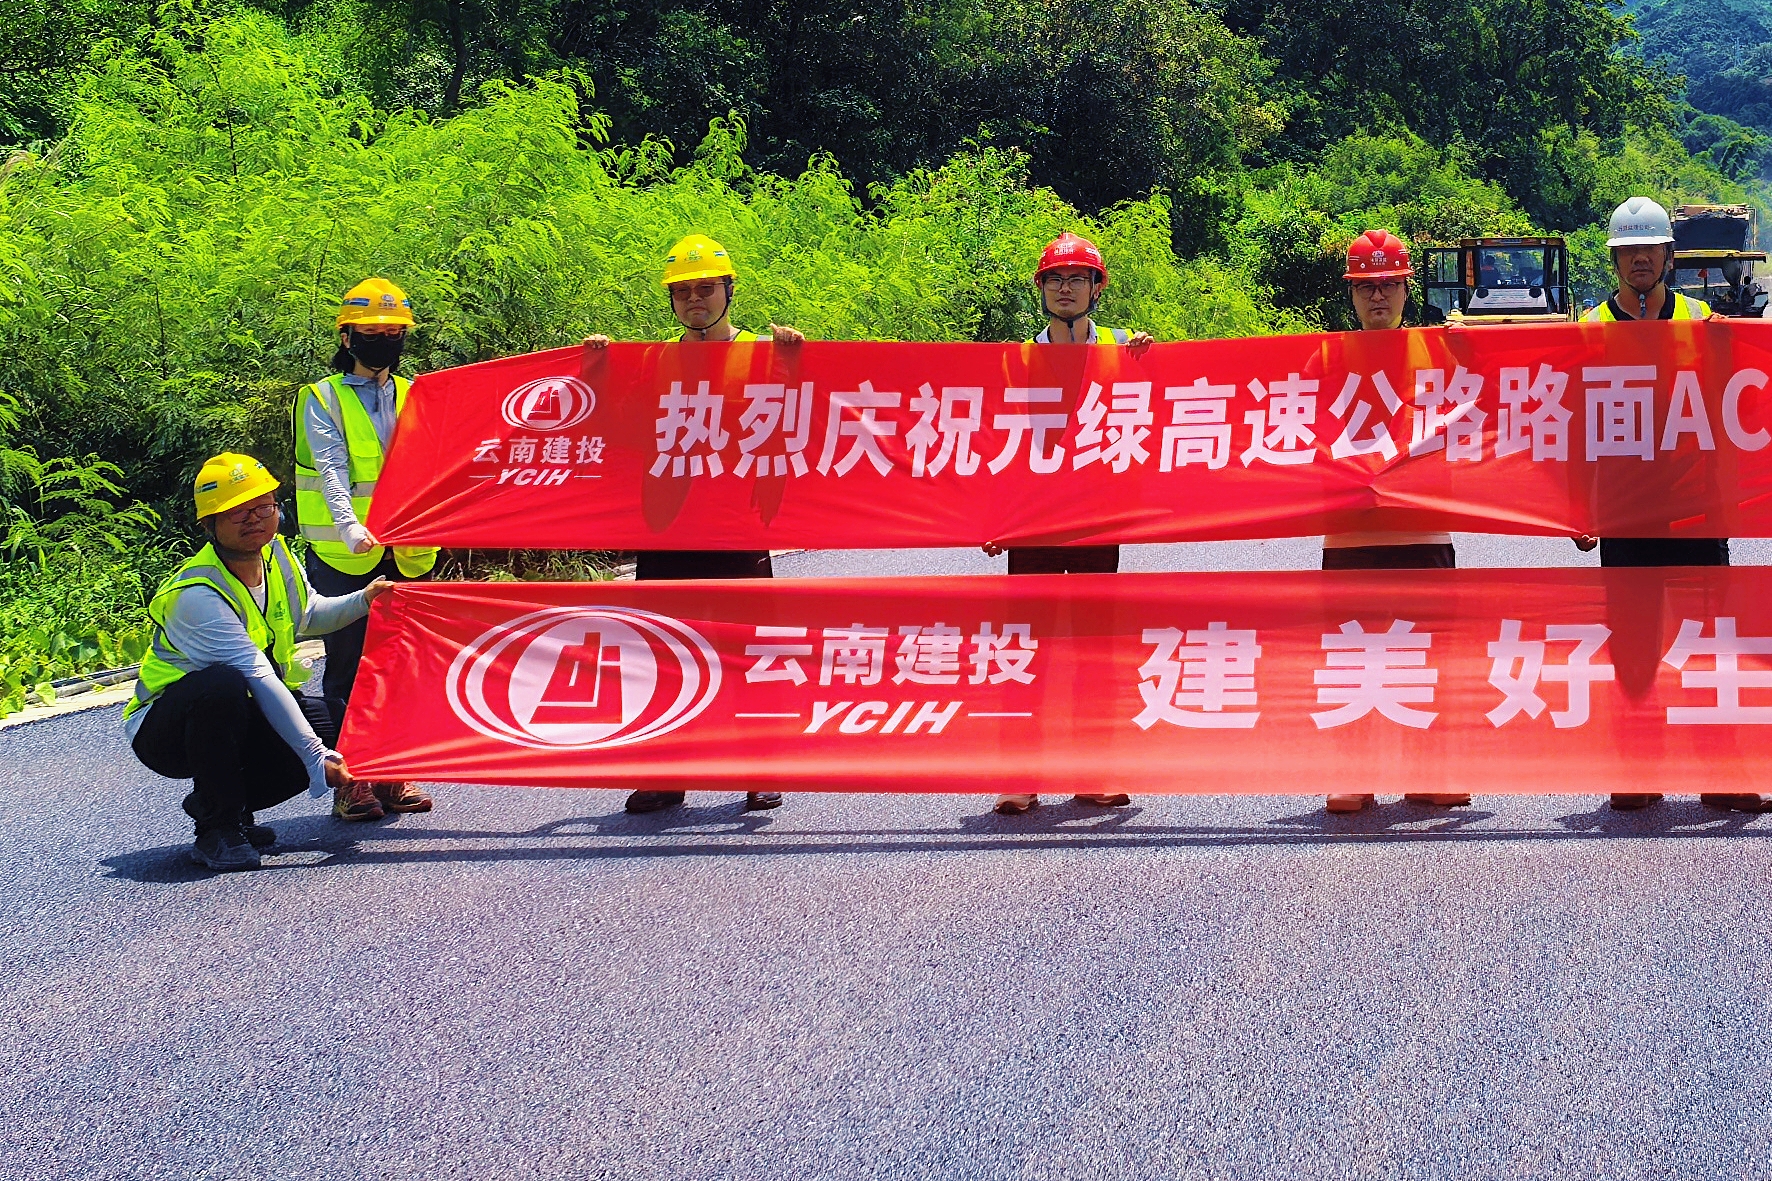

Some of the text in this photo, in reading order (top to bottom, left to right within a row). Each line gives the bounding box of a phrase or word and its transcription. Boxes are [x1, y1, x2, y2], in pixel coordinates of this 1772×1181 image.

[472, 435, 606, 464] 云南建投
[497, 468, 572, 486] YCIH
[744, 621, 1039, 687] 云南建投
[802, 700, 964, 735] YCIH
